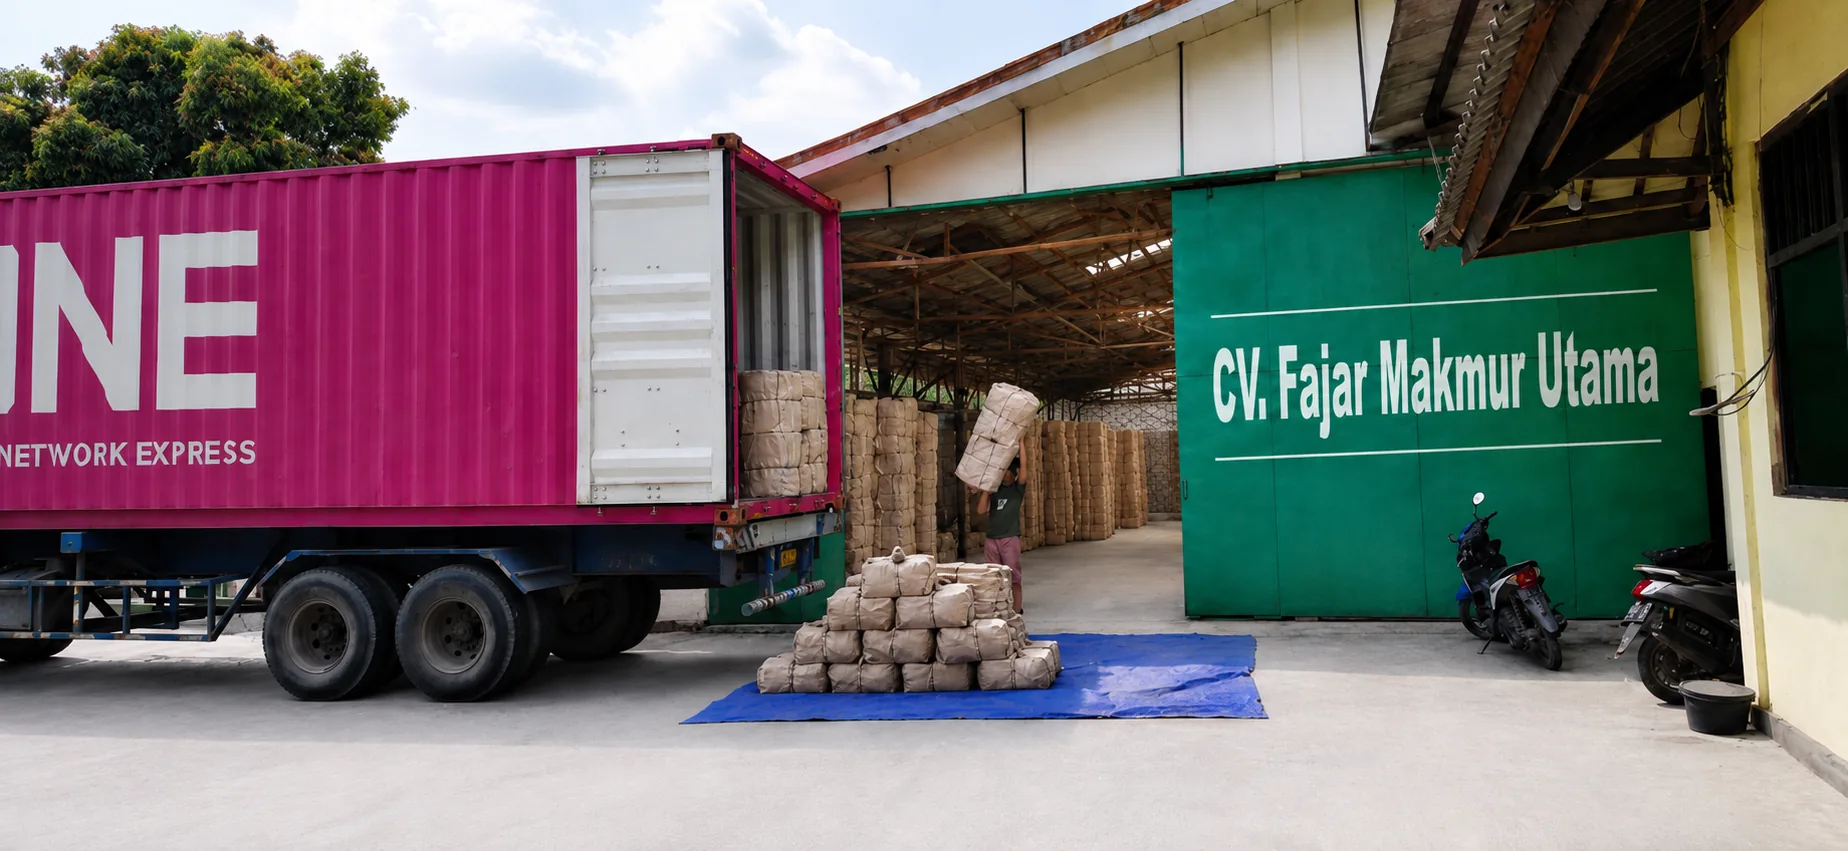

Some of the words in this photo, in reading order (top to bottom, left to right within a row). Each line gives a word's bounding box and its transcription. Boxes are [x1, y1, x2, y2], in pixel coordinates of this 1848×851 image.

[1214, 347, 1266, 422] CV.
[1279, 344, 1368, 438] Fajar
[1380, 338, 1525, 414] Makmur
[1539, 332, 1658, 407] Utama
[0, 442, 127, 467] NETWORK
[137, 440, 255, 465] EXPRESS
